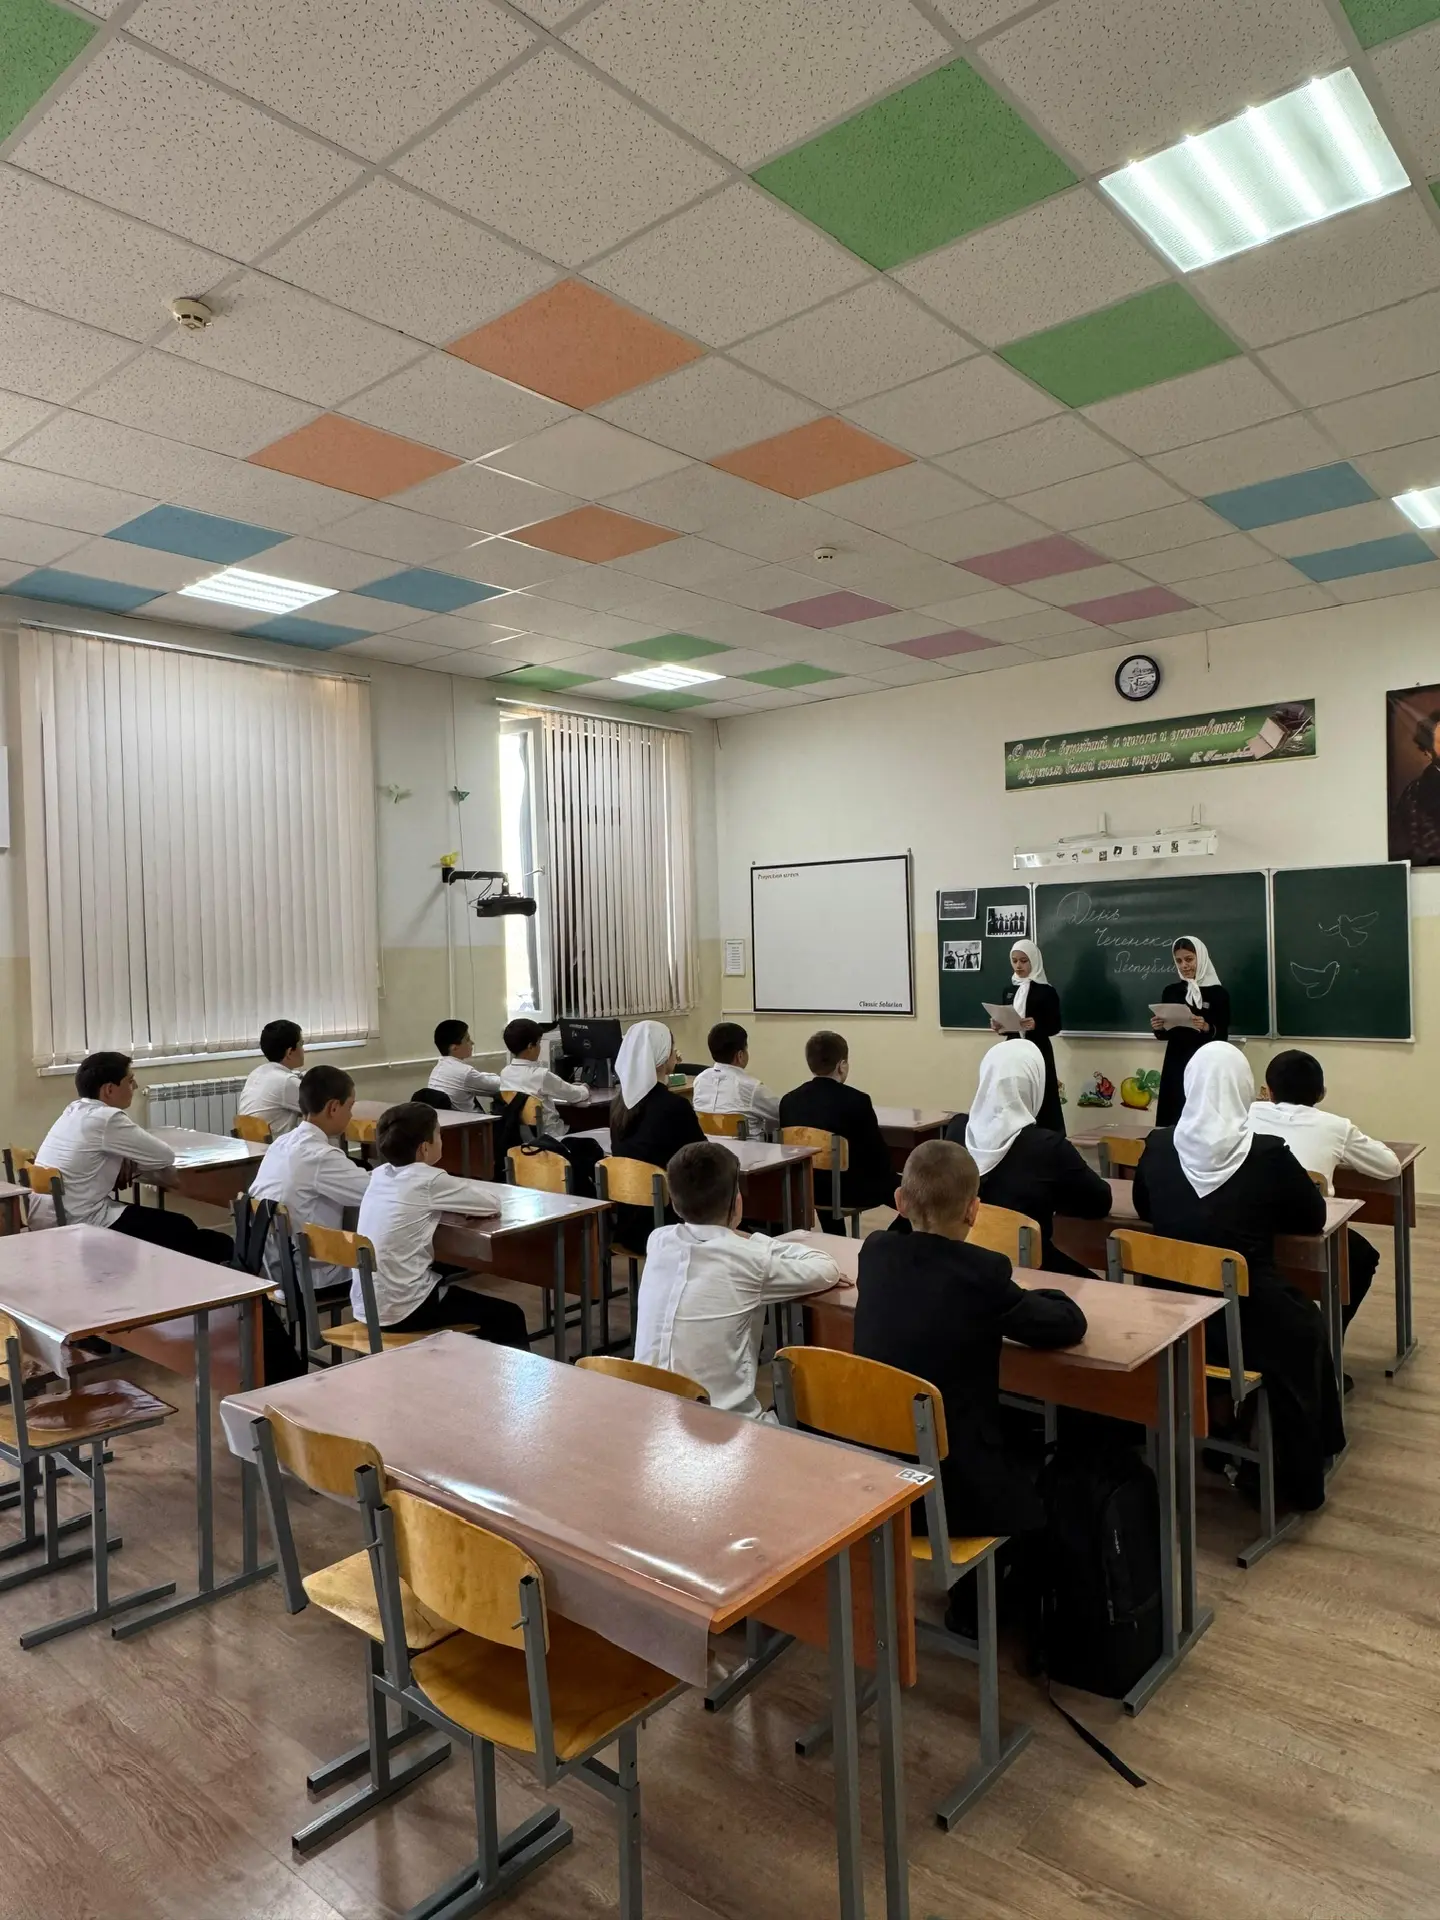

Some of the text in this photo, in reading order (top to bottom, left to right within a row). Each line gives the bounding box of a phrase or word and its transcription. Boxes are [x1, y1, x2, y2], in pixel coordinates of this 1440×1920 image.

[1057, 891, 1120, 925] День
[1094, 927, 1173, 947] Чеченско
[1113, 950, 1177, 981] Республи
